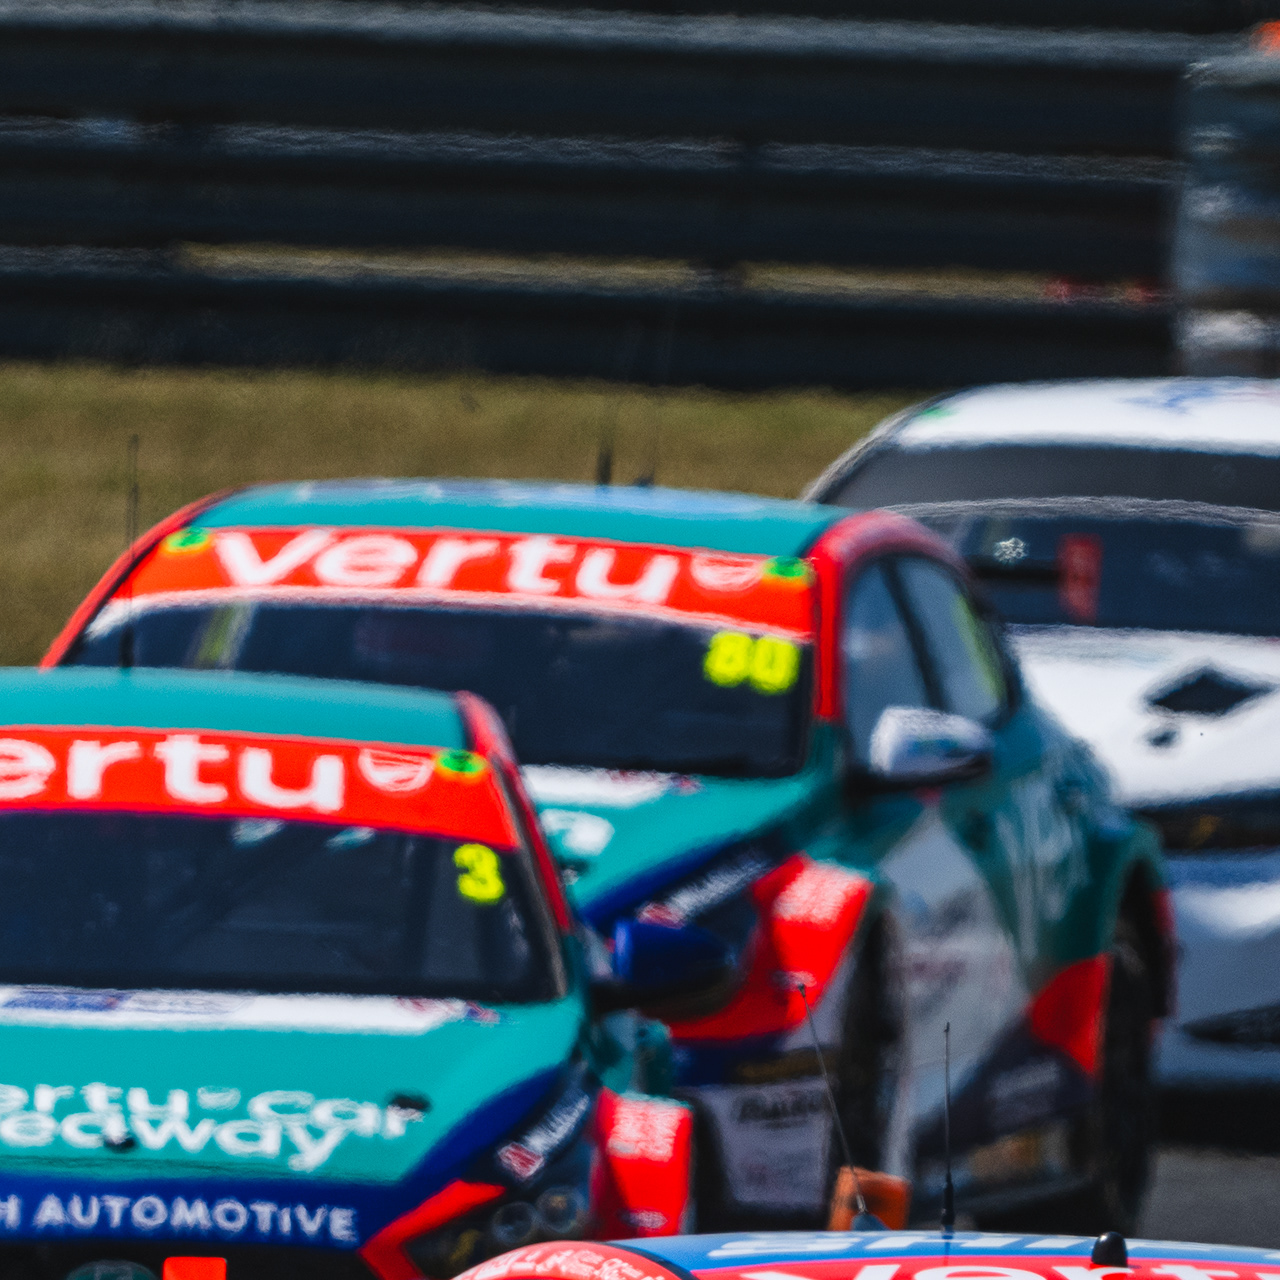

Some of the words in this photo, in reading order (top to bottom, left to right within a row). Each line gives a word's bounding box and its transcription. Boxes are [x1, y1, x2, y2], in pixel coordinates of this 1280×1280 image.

[704, 630, 800, 692] 80
[452, 843, 504, 903] 3
[32, 1193, 360, 1245] AUTOMOTIVE
